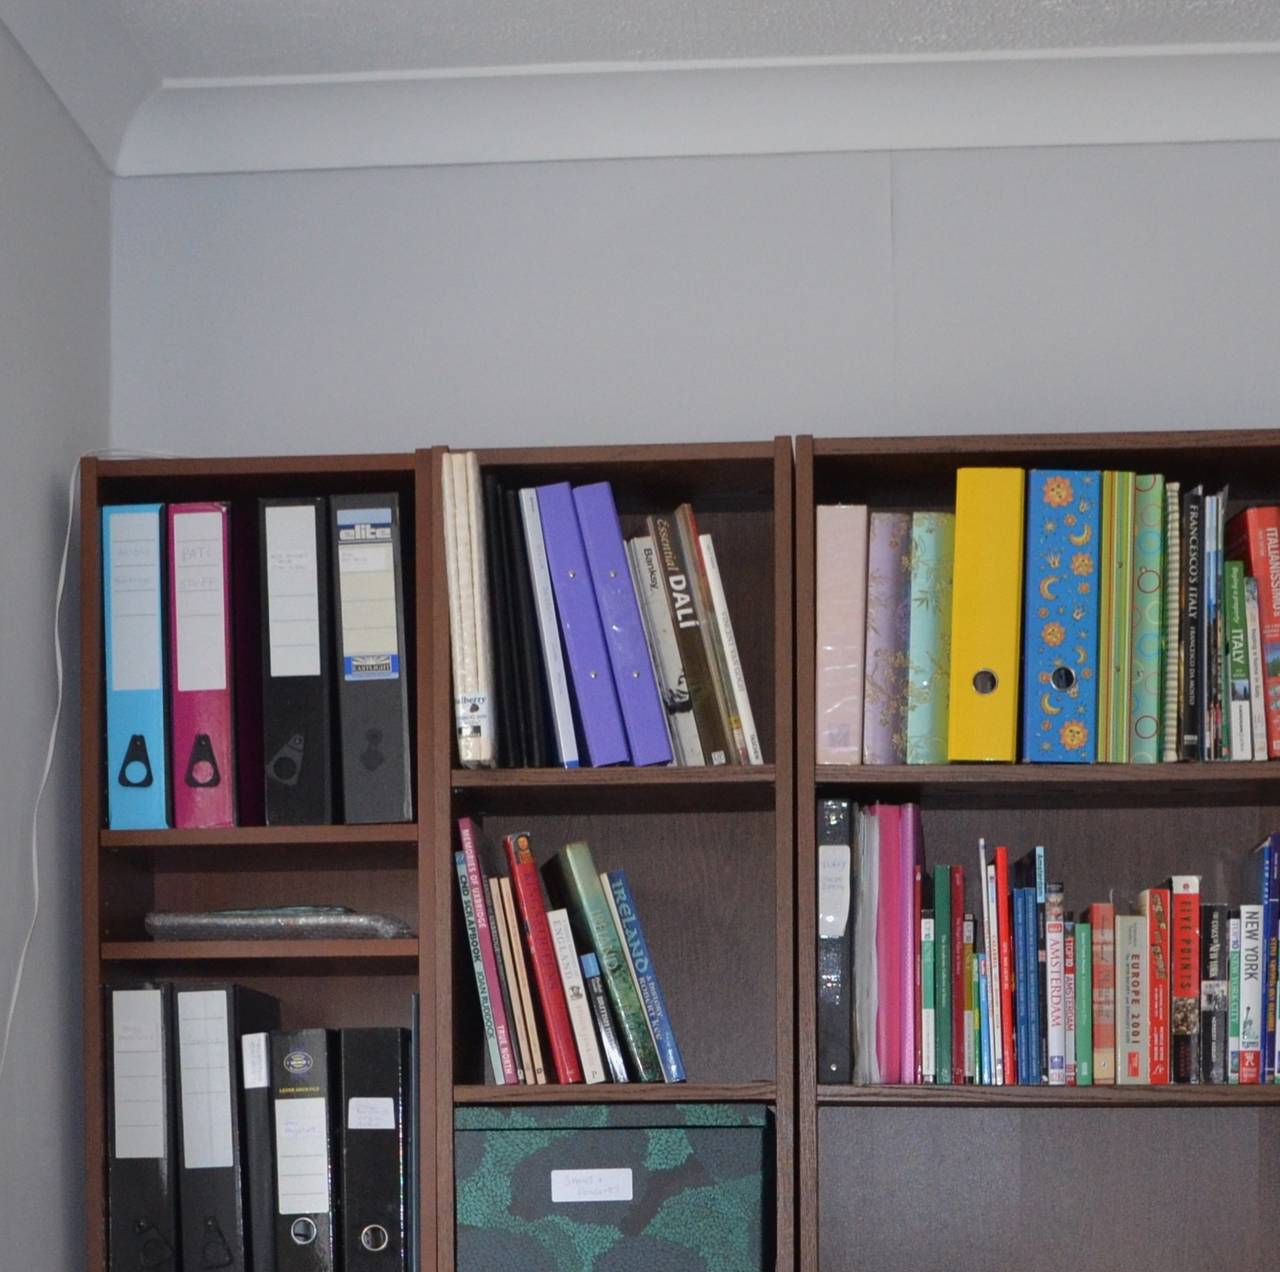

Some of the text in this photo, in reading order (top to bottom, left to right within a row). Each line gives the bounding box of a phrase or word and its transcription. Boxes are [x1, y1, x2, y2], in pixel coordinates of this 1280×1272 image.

[340, 525, 392, 541] elite
[1188, 505, 1199, 620] FRANCESCO'S ITALY
[668, 575, 701, 629] DALÍ
[1232, 629, 1243, 664] ITALY
[461, 829, 487, 929] MEMORIES OF UXBRIDGE
[459, 875, 481, 962] CND SCRAPBOOK
[553, 920, 573, 980] ENGLAND
[1180, 901, 1192, 989] FIVE POINTS
[1244, 911, 1259, 981] NEW YORK
[476, 971, 495, 1039] JOAN RUDDOCK
[1050, 938, 1062, 1027] AMSTERDAM
[1066, 975, 1074, 1032] AMSTERDAM
[1131, 954, 1140, 1005] EUROPE
[1230, 953, 1239, 1024] NEW YORK CITY
[496, 1025, 513, 1075] TRUE NORTH
[1131, 1013, 1140, 1044] 2001
